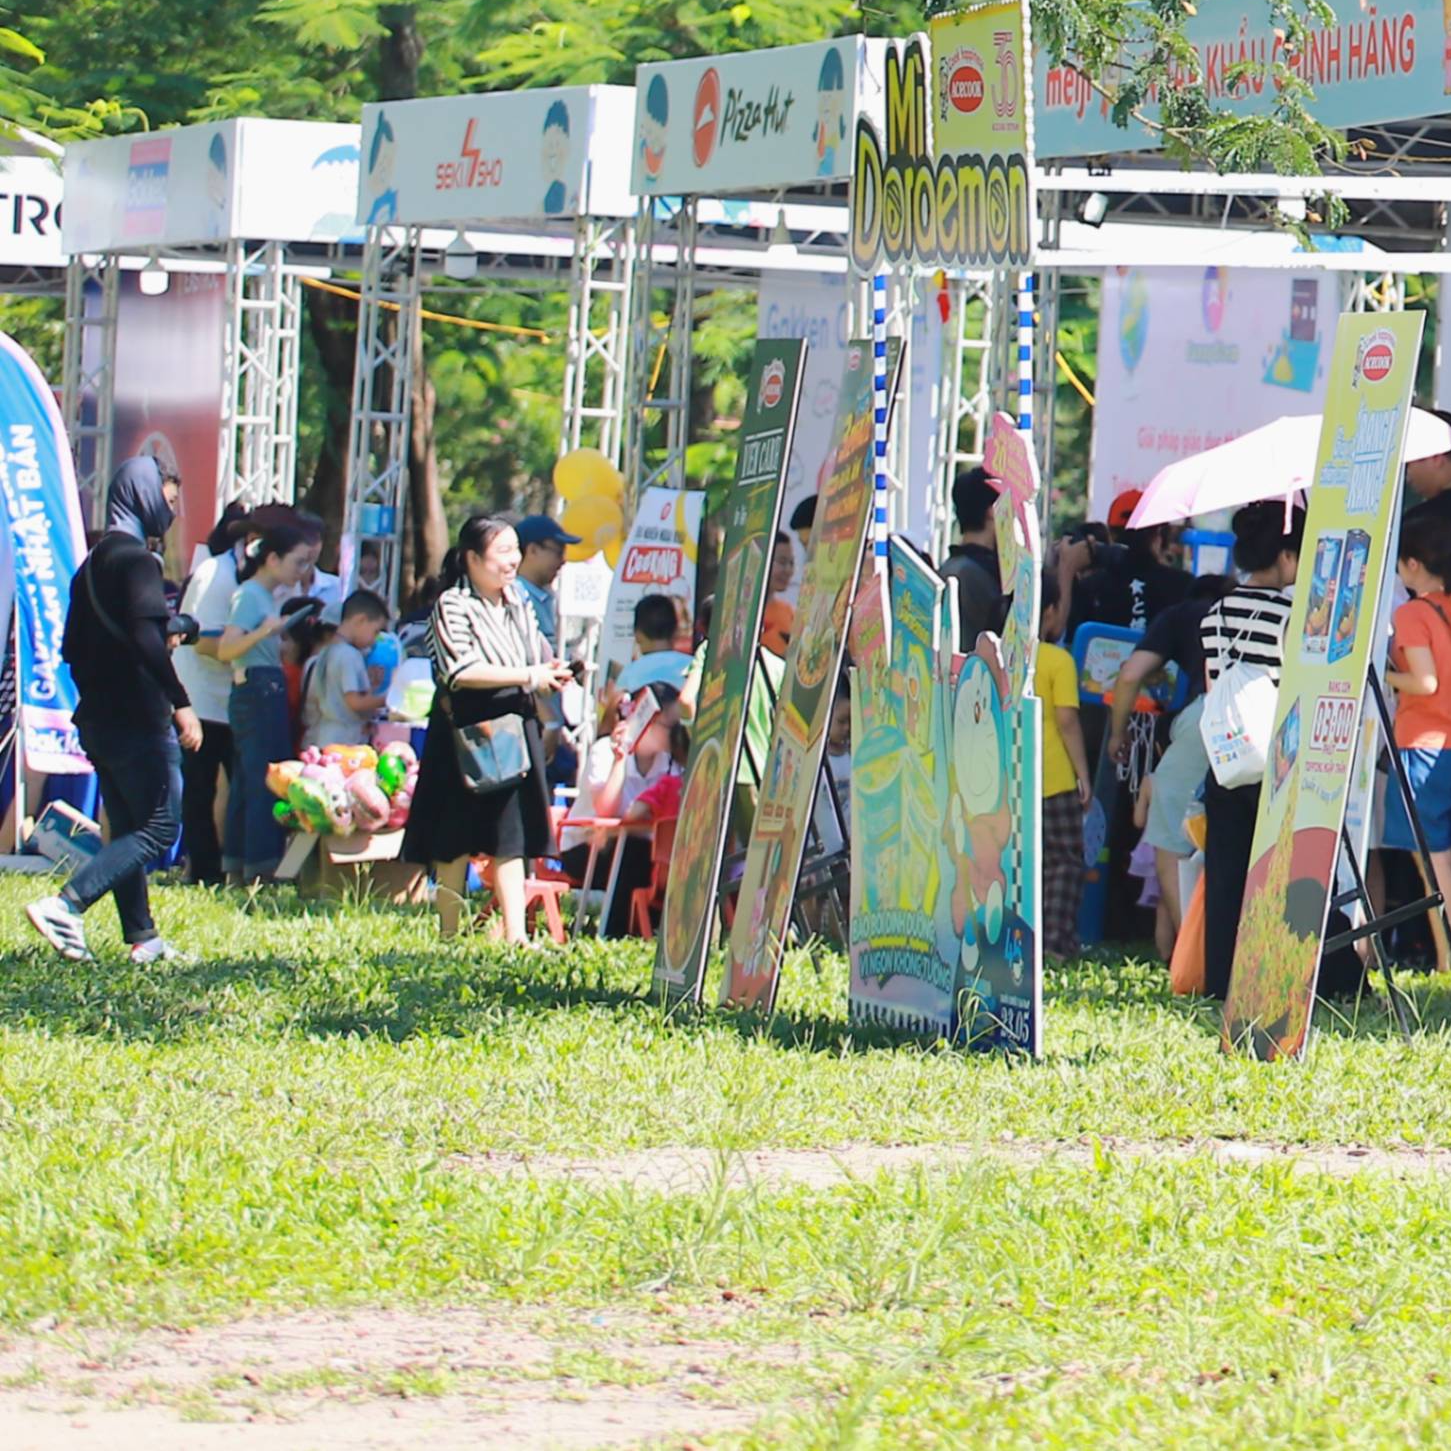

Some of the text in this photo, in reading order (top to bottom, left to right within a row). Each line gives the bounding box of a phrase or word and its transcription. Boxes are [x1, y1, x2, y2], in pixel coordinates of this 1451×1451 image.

[1347, 7, 1415, 79] HÃNG
[719, 84, 796, 148] Pizza Hut
[852, 116, 1029, 270] Doraemon
[1313, 701, 1355, 743] 03:00
